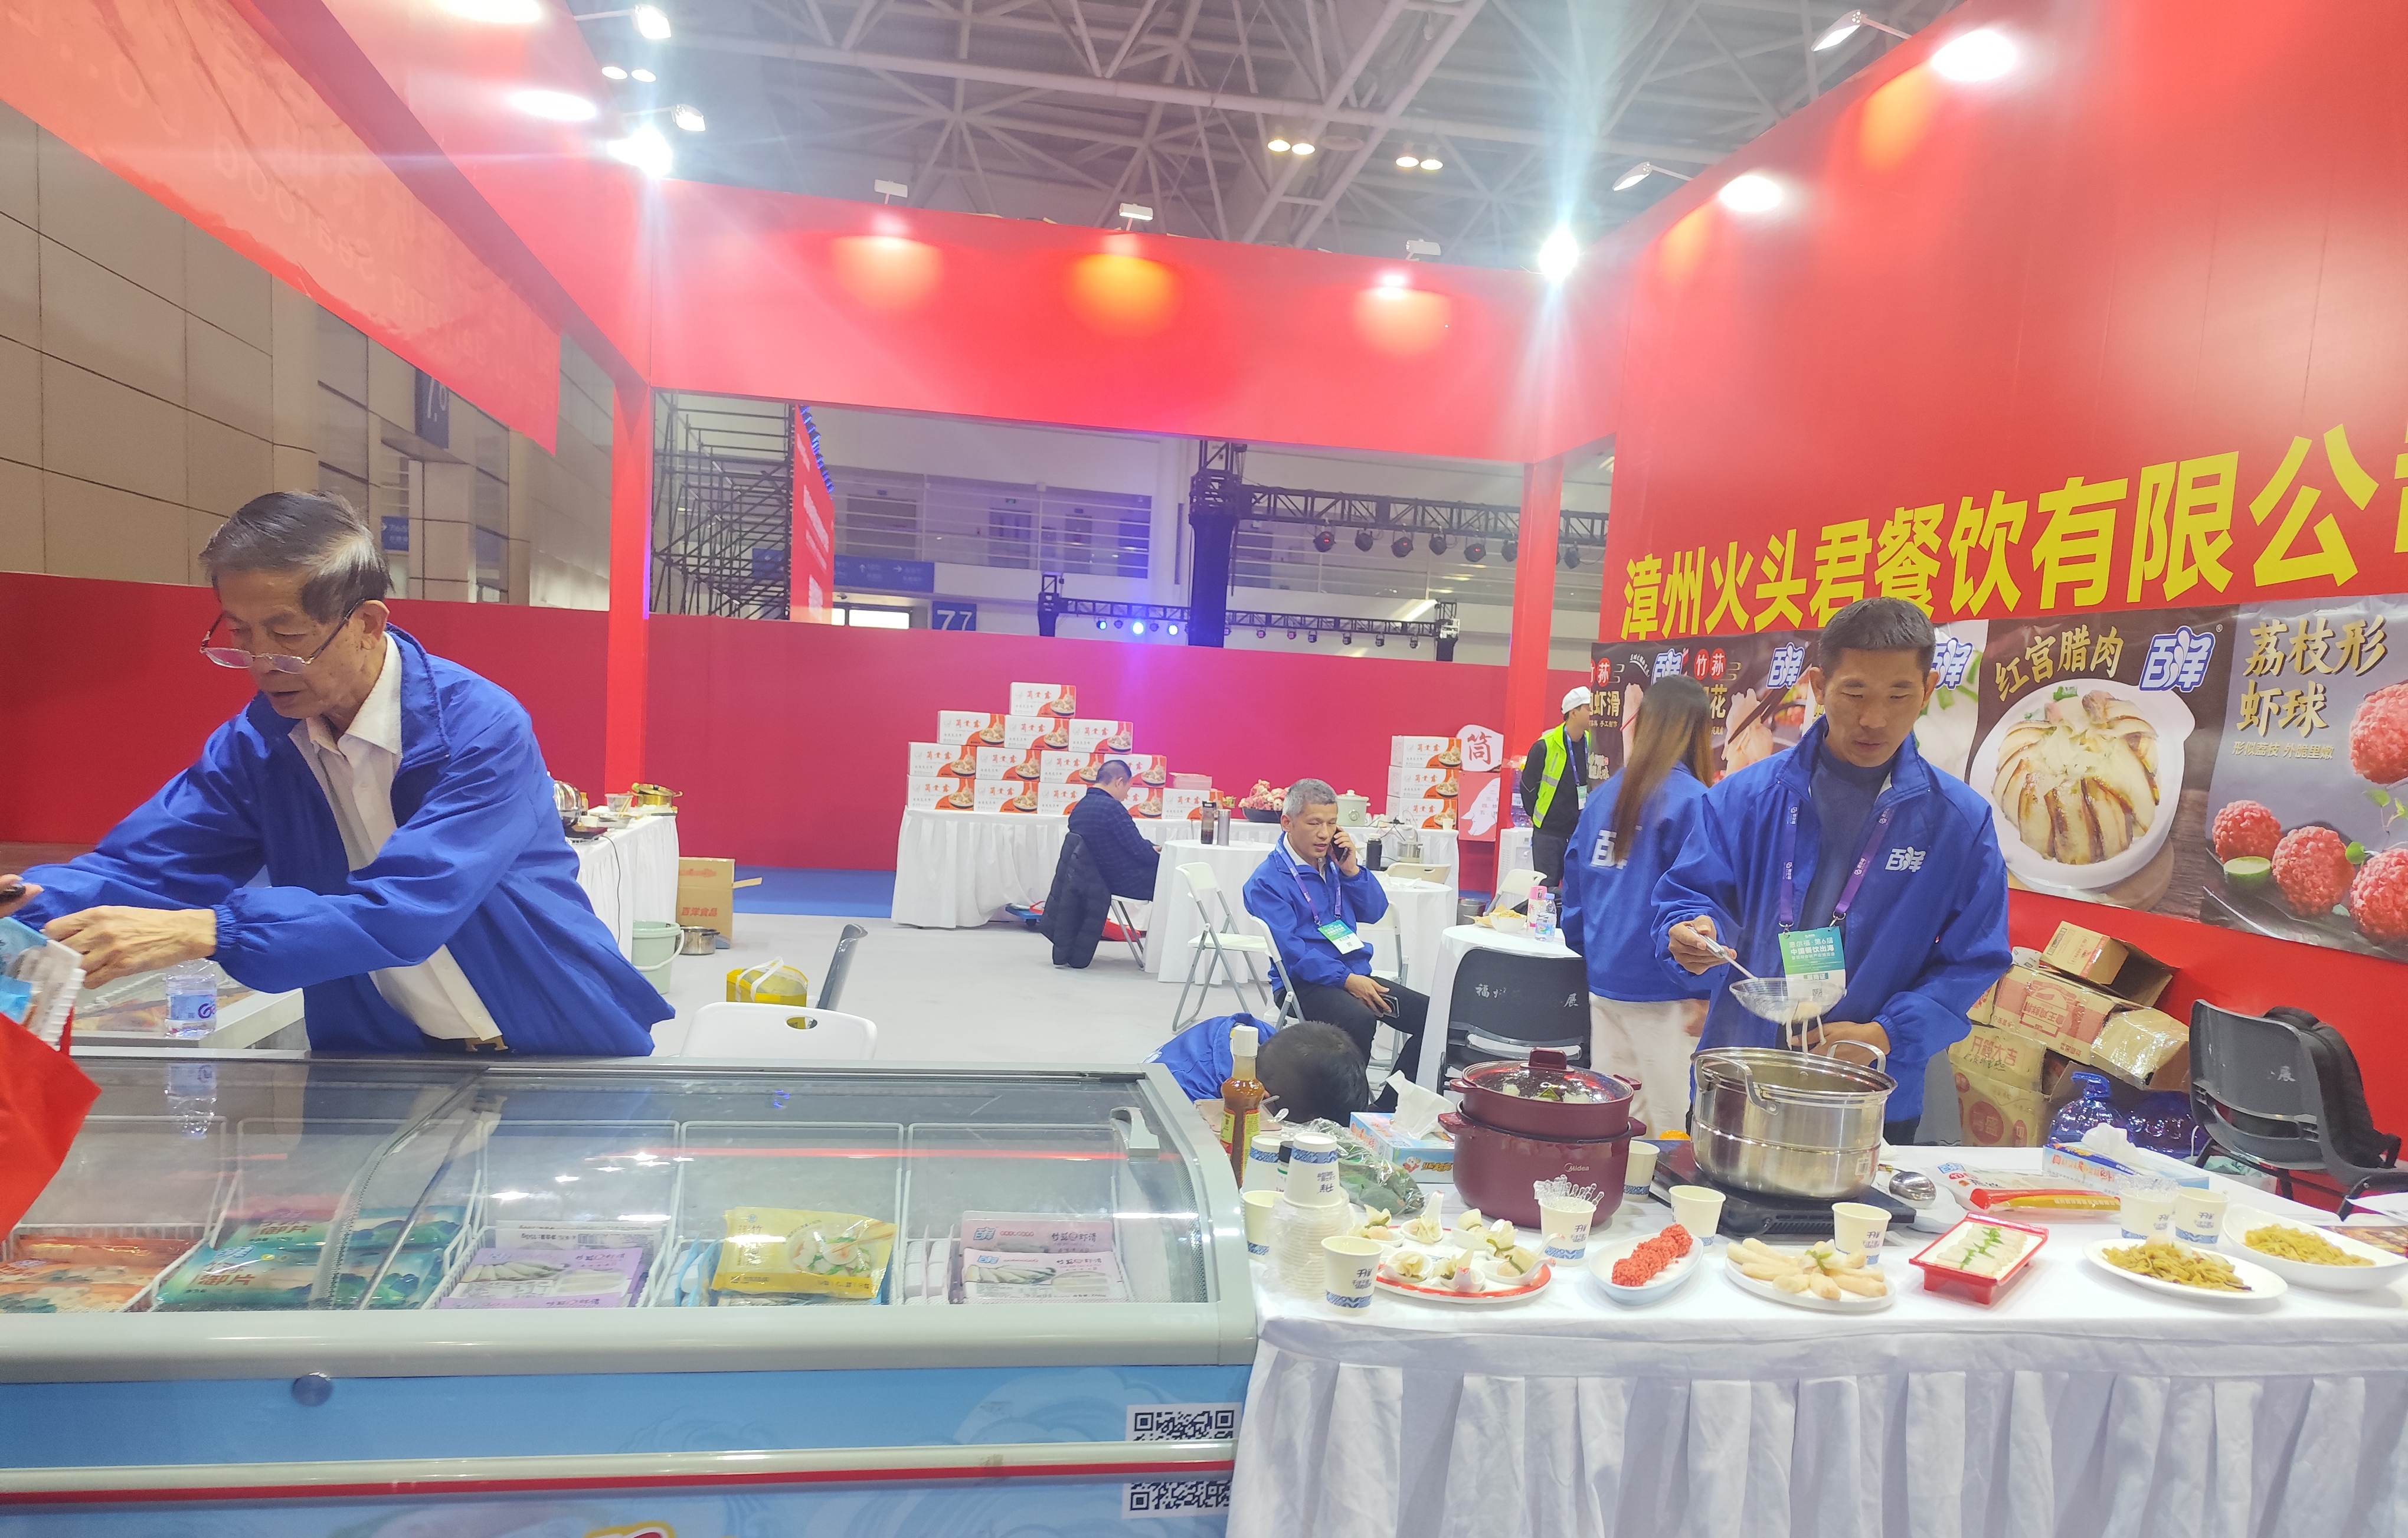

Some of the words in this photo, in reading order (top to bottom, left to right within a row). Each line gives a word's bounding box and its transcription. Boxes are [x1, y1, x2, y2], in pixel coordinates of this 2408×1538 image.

[1621, 421, 2408, 640] 漳州火头君餐饮有限公
[937, 609, 979, 630] 77
[1995, 624, 2124, 702] 红宫腊肉
[2243, 614, 2387, 677] 荔枝形
[1704, 683, 1727, 719] 花
[2237, 679, 2330, 738] 虾球
[1468, 731, 1492, 765] 筒
[1564, 1163, 1589, 1173] Midea
